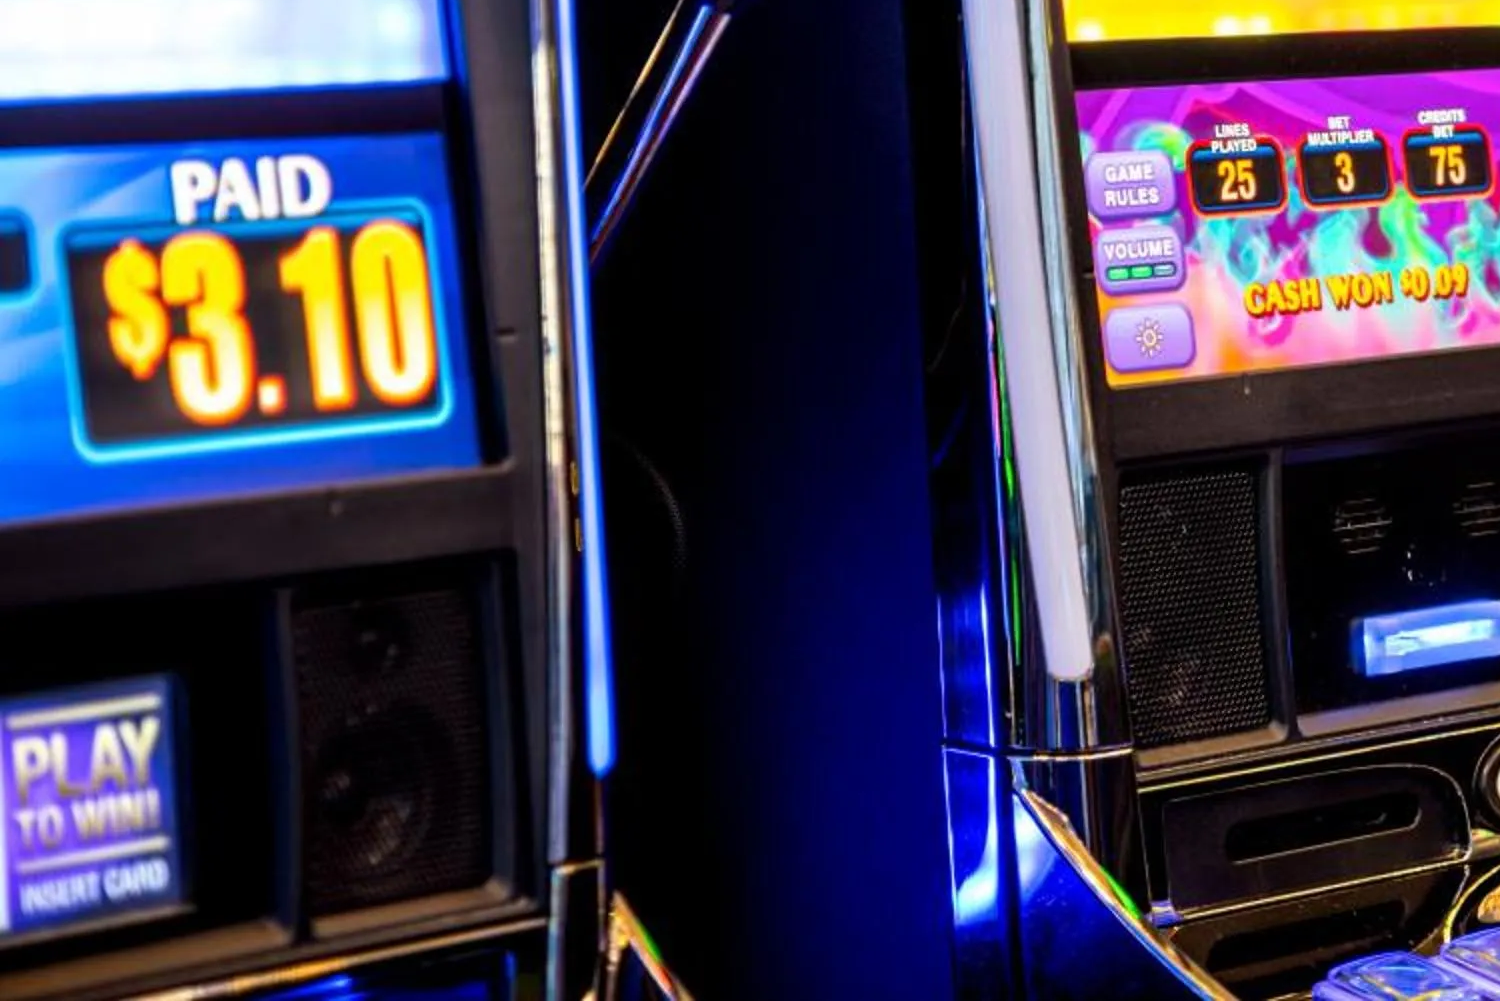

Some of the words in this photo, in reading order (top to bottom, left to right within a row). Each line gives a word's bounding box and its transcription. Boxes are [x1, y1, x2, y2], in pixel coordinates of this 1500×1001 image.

[1214, 123, 1250, 140] LINES
[1327, 115, 1350, 131] BET
[1418, 108, 1466, 125] CREDITS
[1432, 124, 1455, 139] BET
[1210, 137, 1258, 154] PLAYED
[1307, 129, 1375, 146] MULTIPLIER
[1104, 161, 1154, 183] GAME
[1217, 159, 1257, 201] 25
[1335, 151, 1356, 193] 3
[1429, 145, 1467, 187] 75
[170, 154, 332, 225] PAID
[1104, 186, 1160, 208] RULES
[1103, 238, 1175, 261] VOLUME
[1243, 279, 1322, 317] CASH
[1326, 271, 1393, 310] WON
[103, 218, 437, 426] $3.10
[12, 716, 160, 805] PLAY
[15, 803, 65, 848] TO
[71, 788, 161, 840] WIN!
[20, 871, 100, 917] INSERT
[103, 858, 171, 900] CARD
